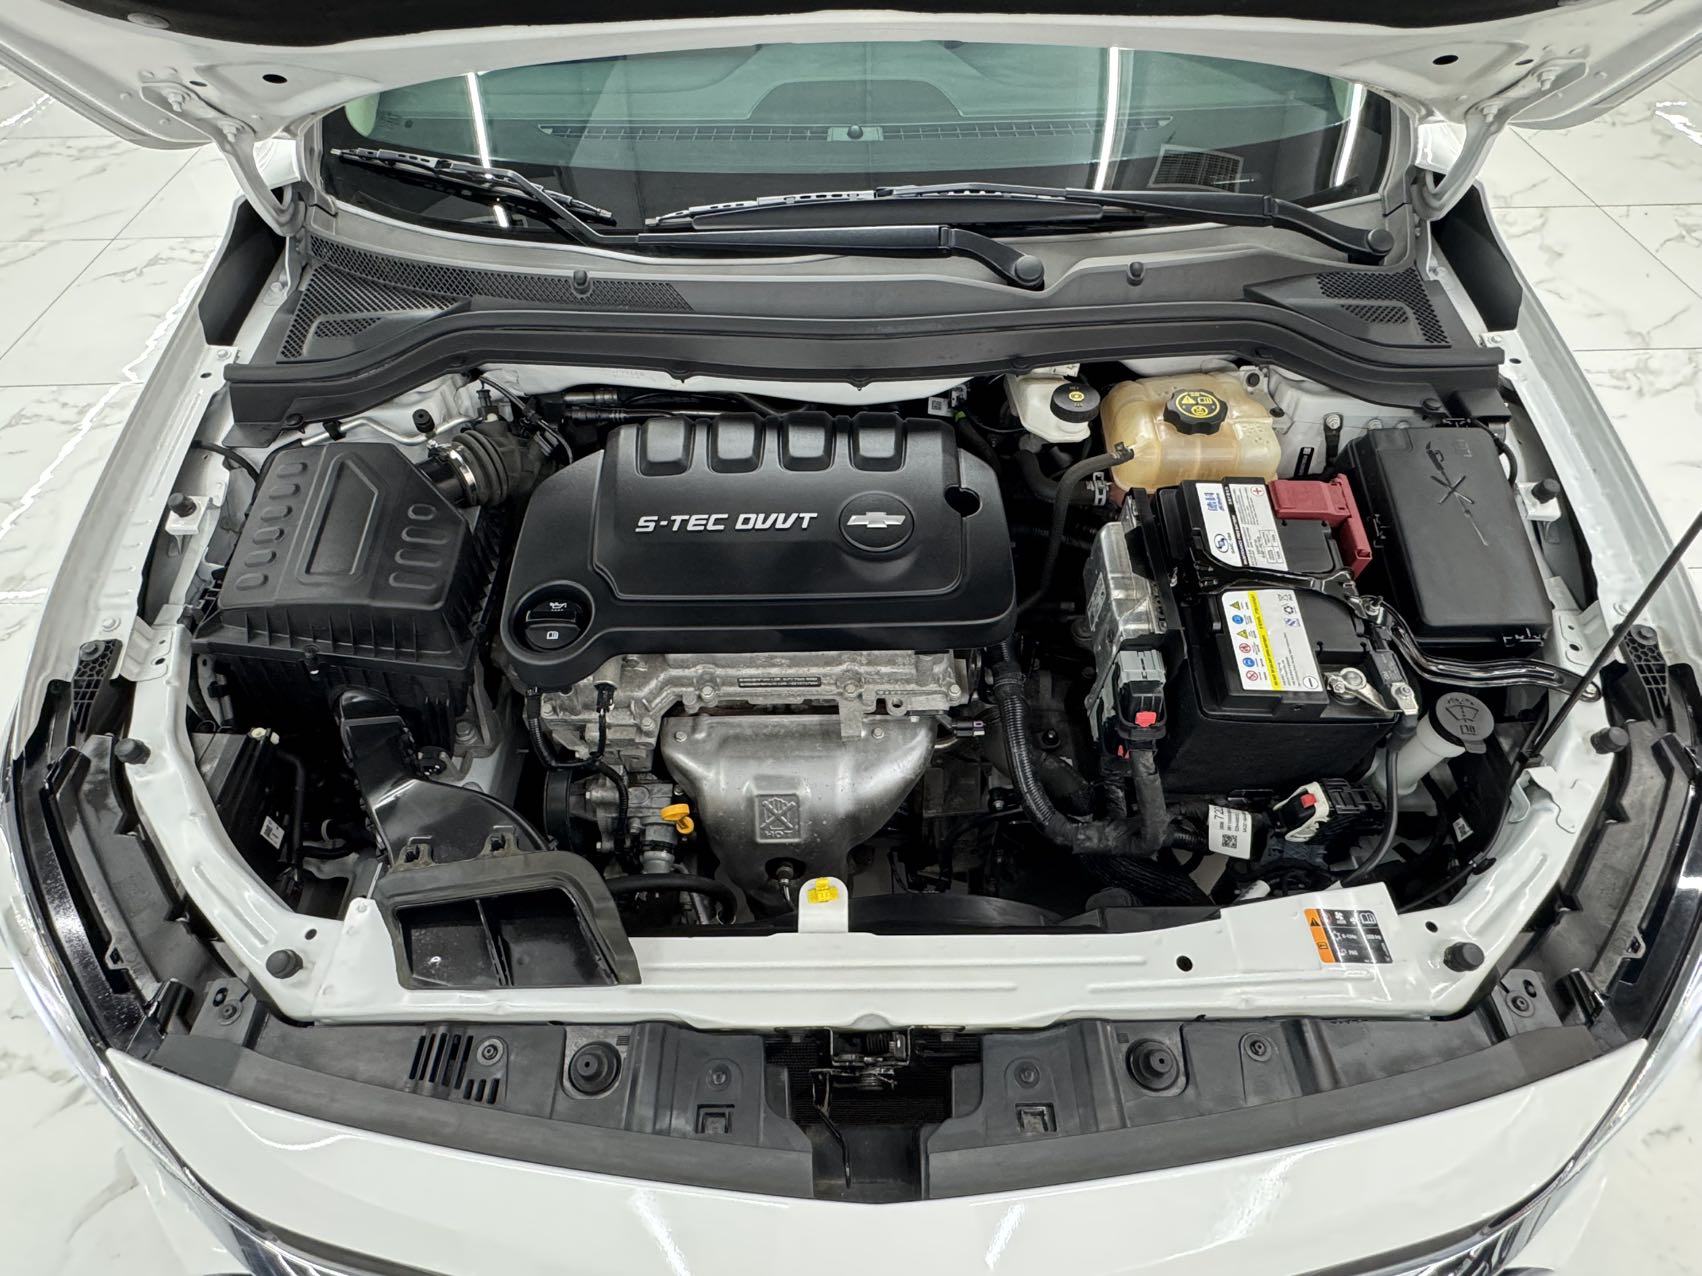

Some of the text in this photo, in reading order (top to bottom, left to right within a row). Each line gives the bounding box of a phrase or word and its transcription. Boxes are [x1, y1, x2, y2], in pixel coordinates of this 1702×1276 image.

[634, 512, 818, 533] S-TEC DVVT
[764, 829, 793, 838] HOT
